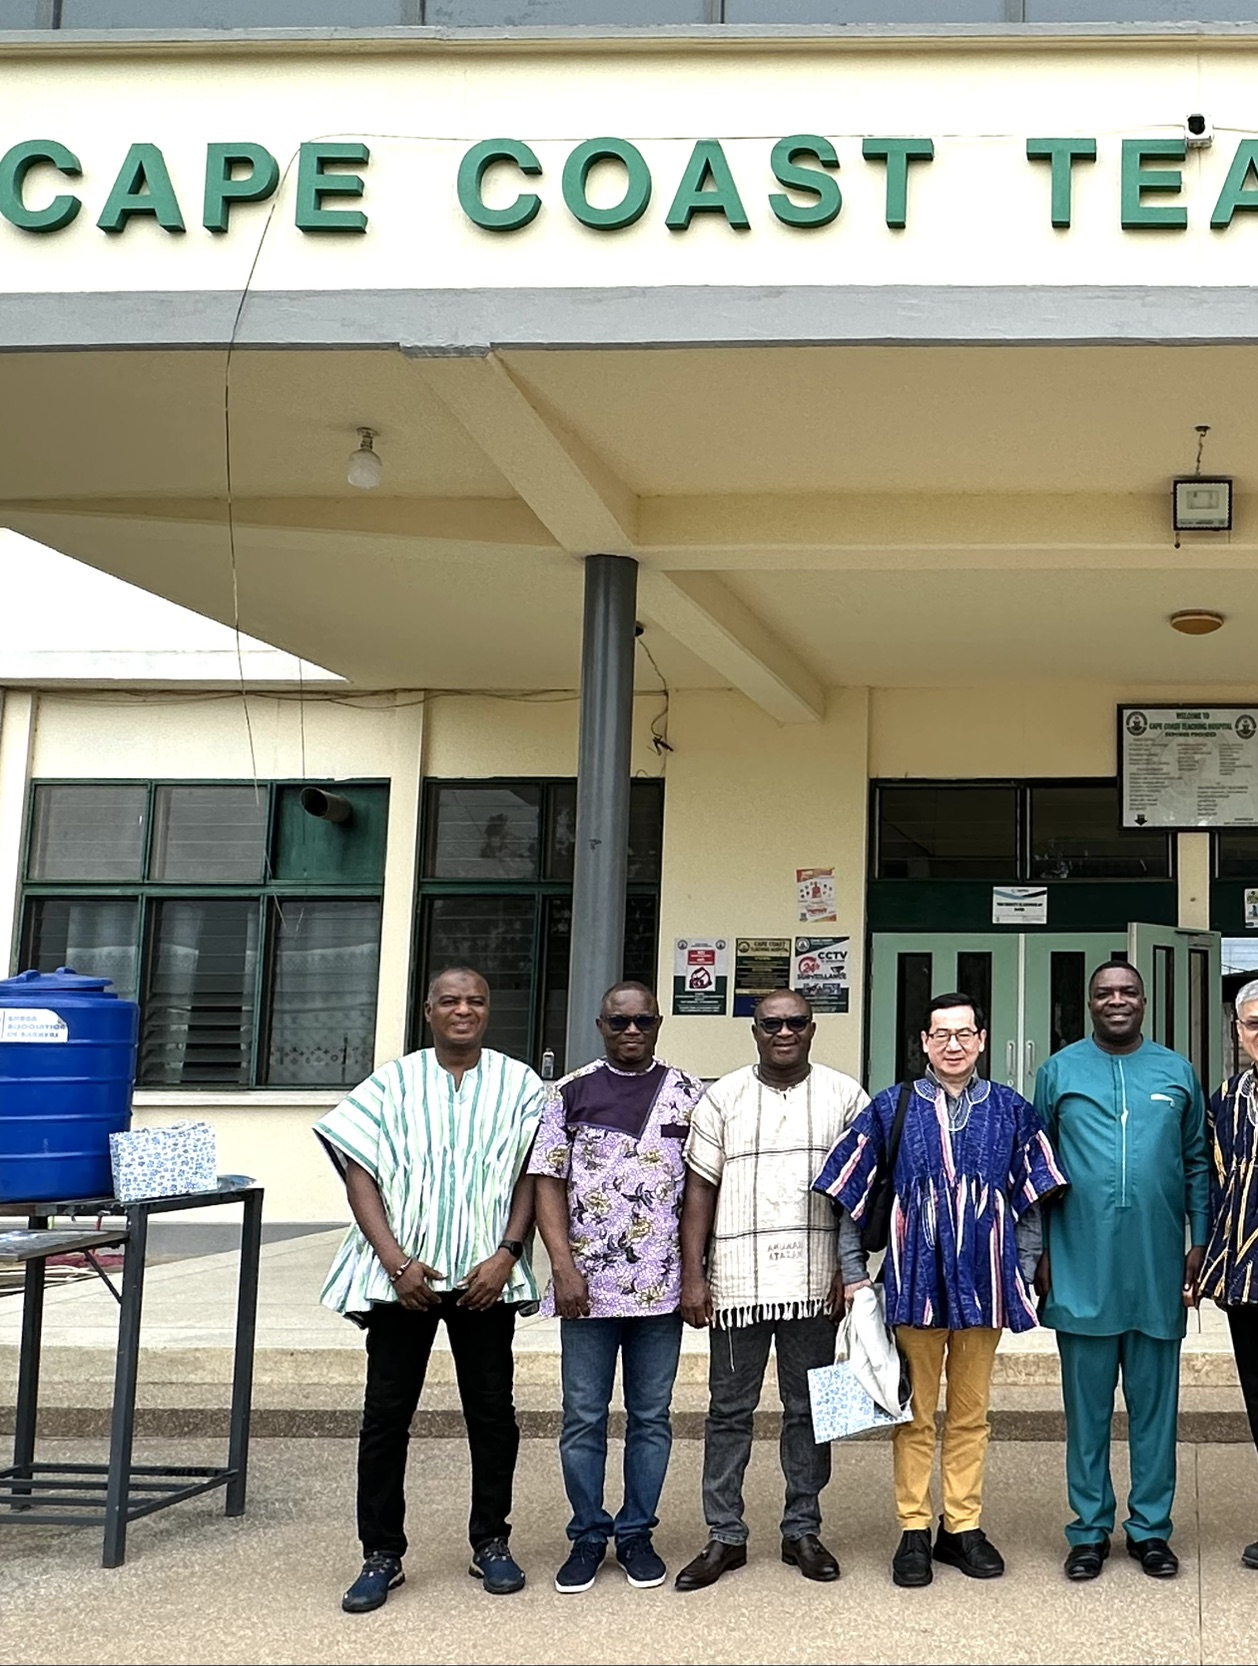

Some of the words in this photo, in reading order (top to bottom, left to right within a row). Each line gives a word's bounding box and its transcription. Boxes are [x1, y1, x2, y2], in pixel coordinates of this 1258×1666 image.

[0, 139, 371, 236] CAPE
[456, 134, 934, 232] COAST
[1149, 722, 1163, 730] CAPE
[1163, 722, 1181, 730] COAST
[1181, 722, 1207, 731] TEACHING
[1207, 722, 1233, 731] HOSPITAL
[817, 950, 848, 960] CCTV
